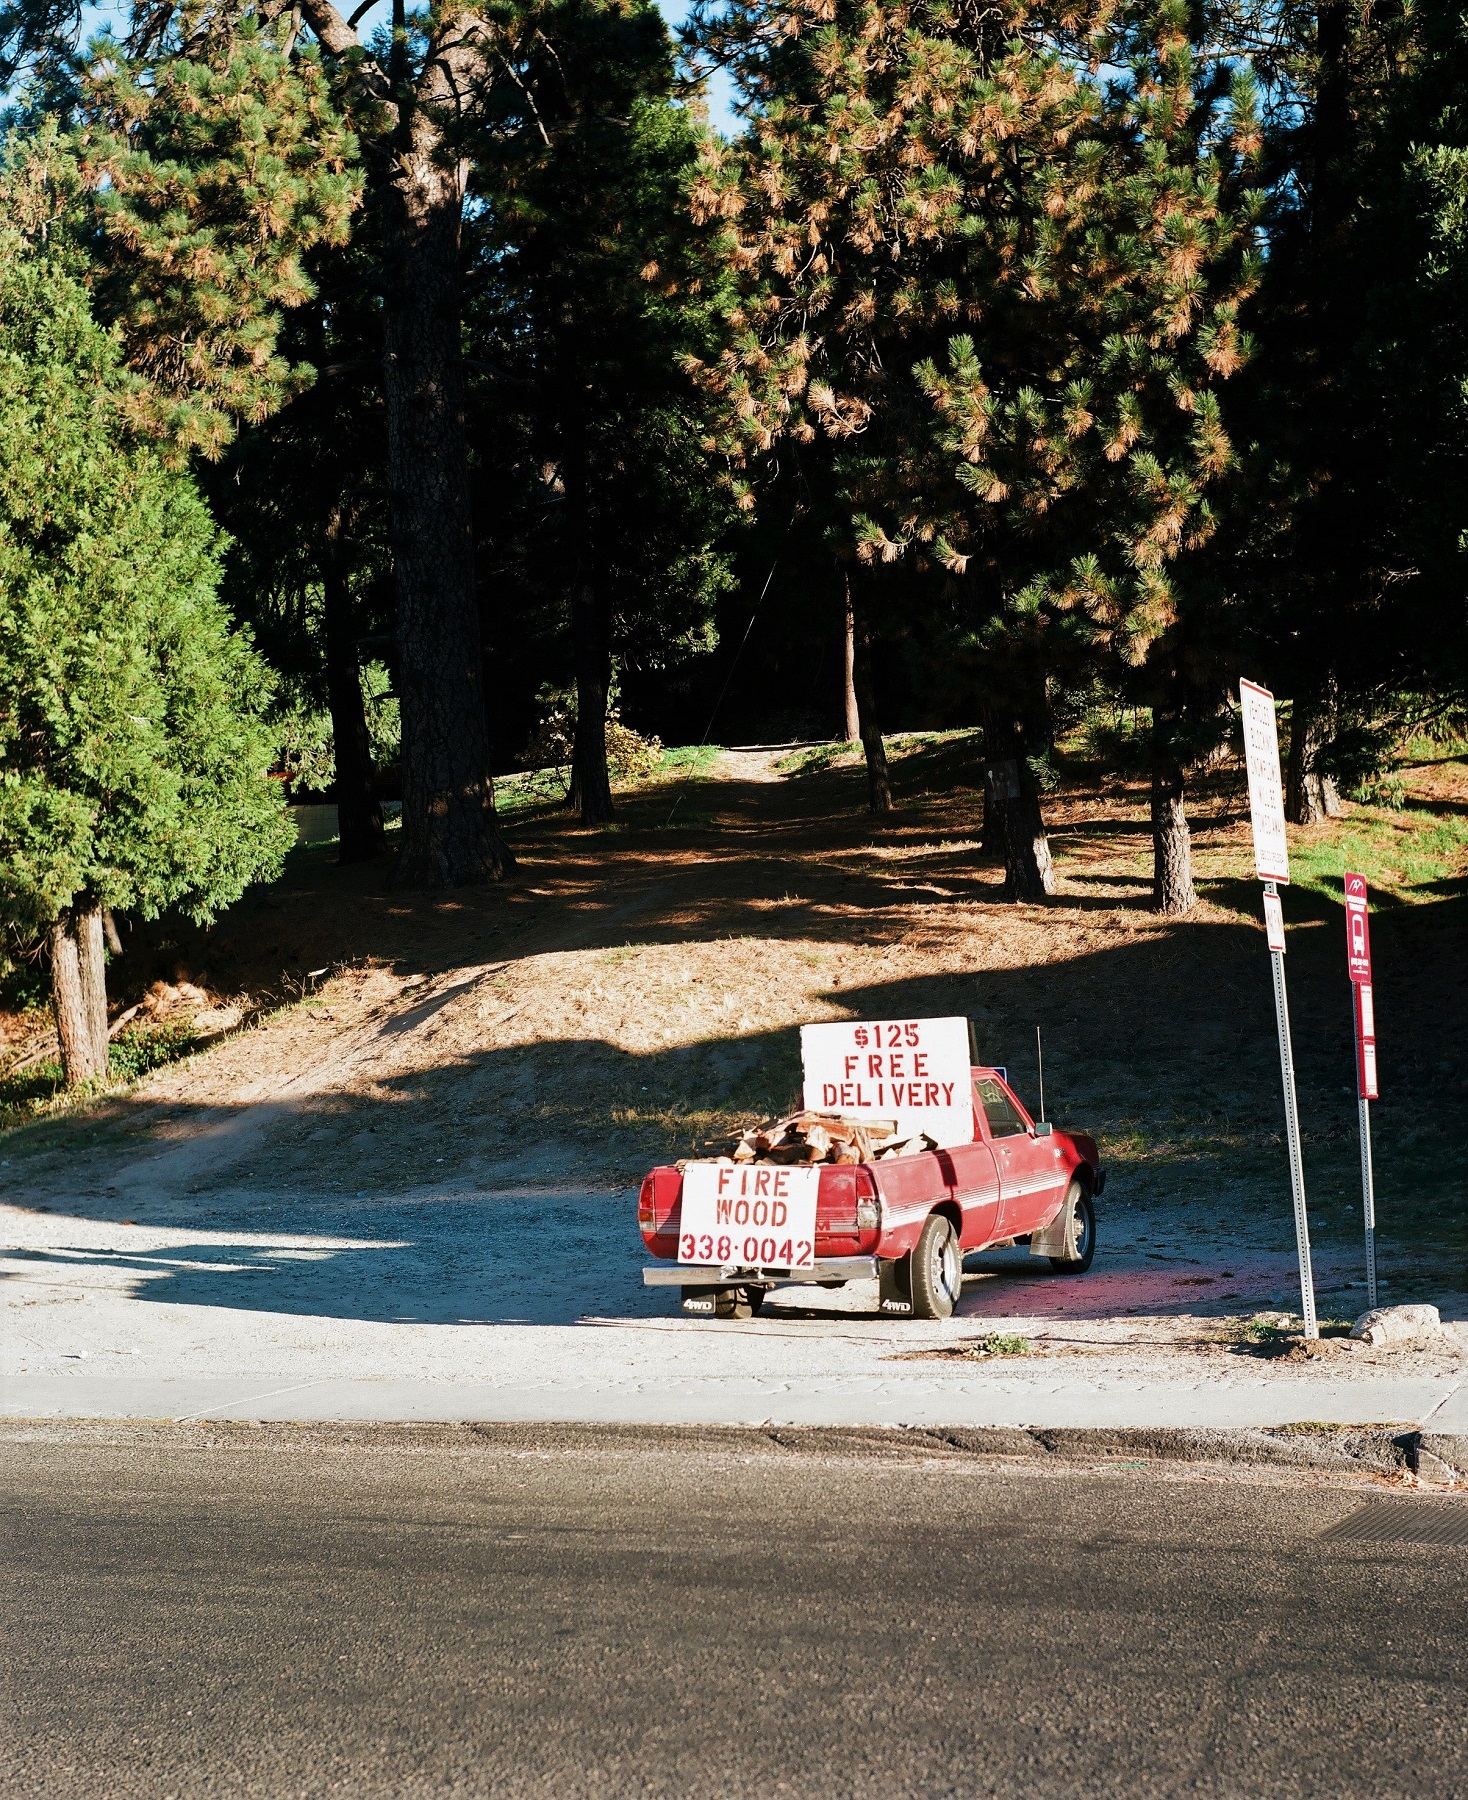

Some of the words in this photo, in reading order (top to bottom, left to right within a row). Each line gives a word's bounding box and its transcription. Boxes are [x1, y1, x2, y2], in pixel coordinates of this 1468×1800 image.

[854, 1023, 919, 1048] $125
[845, 1053, 928, 1079] FREE
[823, 1082, 954, 1107] DELIVERY
[717, 1168, 790, 1197] FIRE
[716, 1199, 787, 1227] WOOD
[683, 1298, 712, 1311] 4WD
[882, 1298, 911, 1311] 4WD
